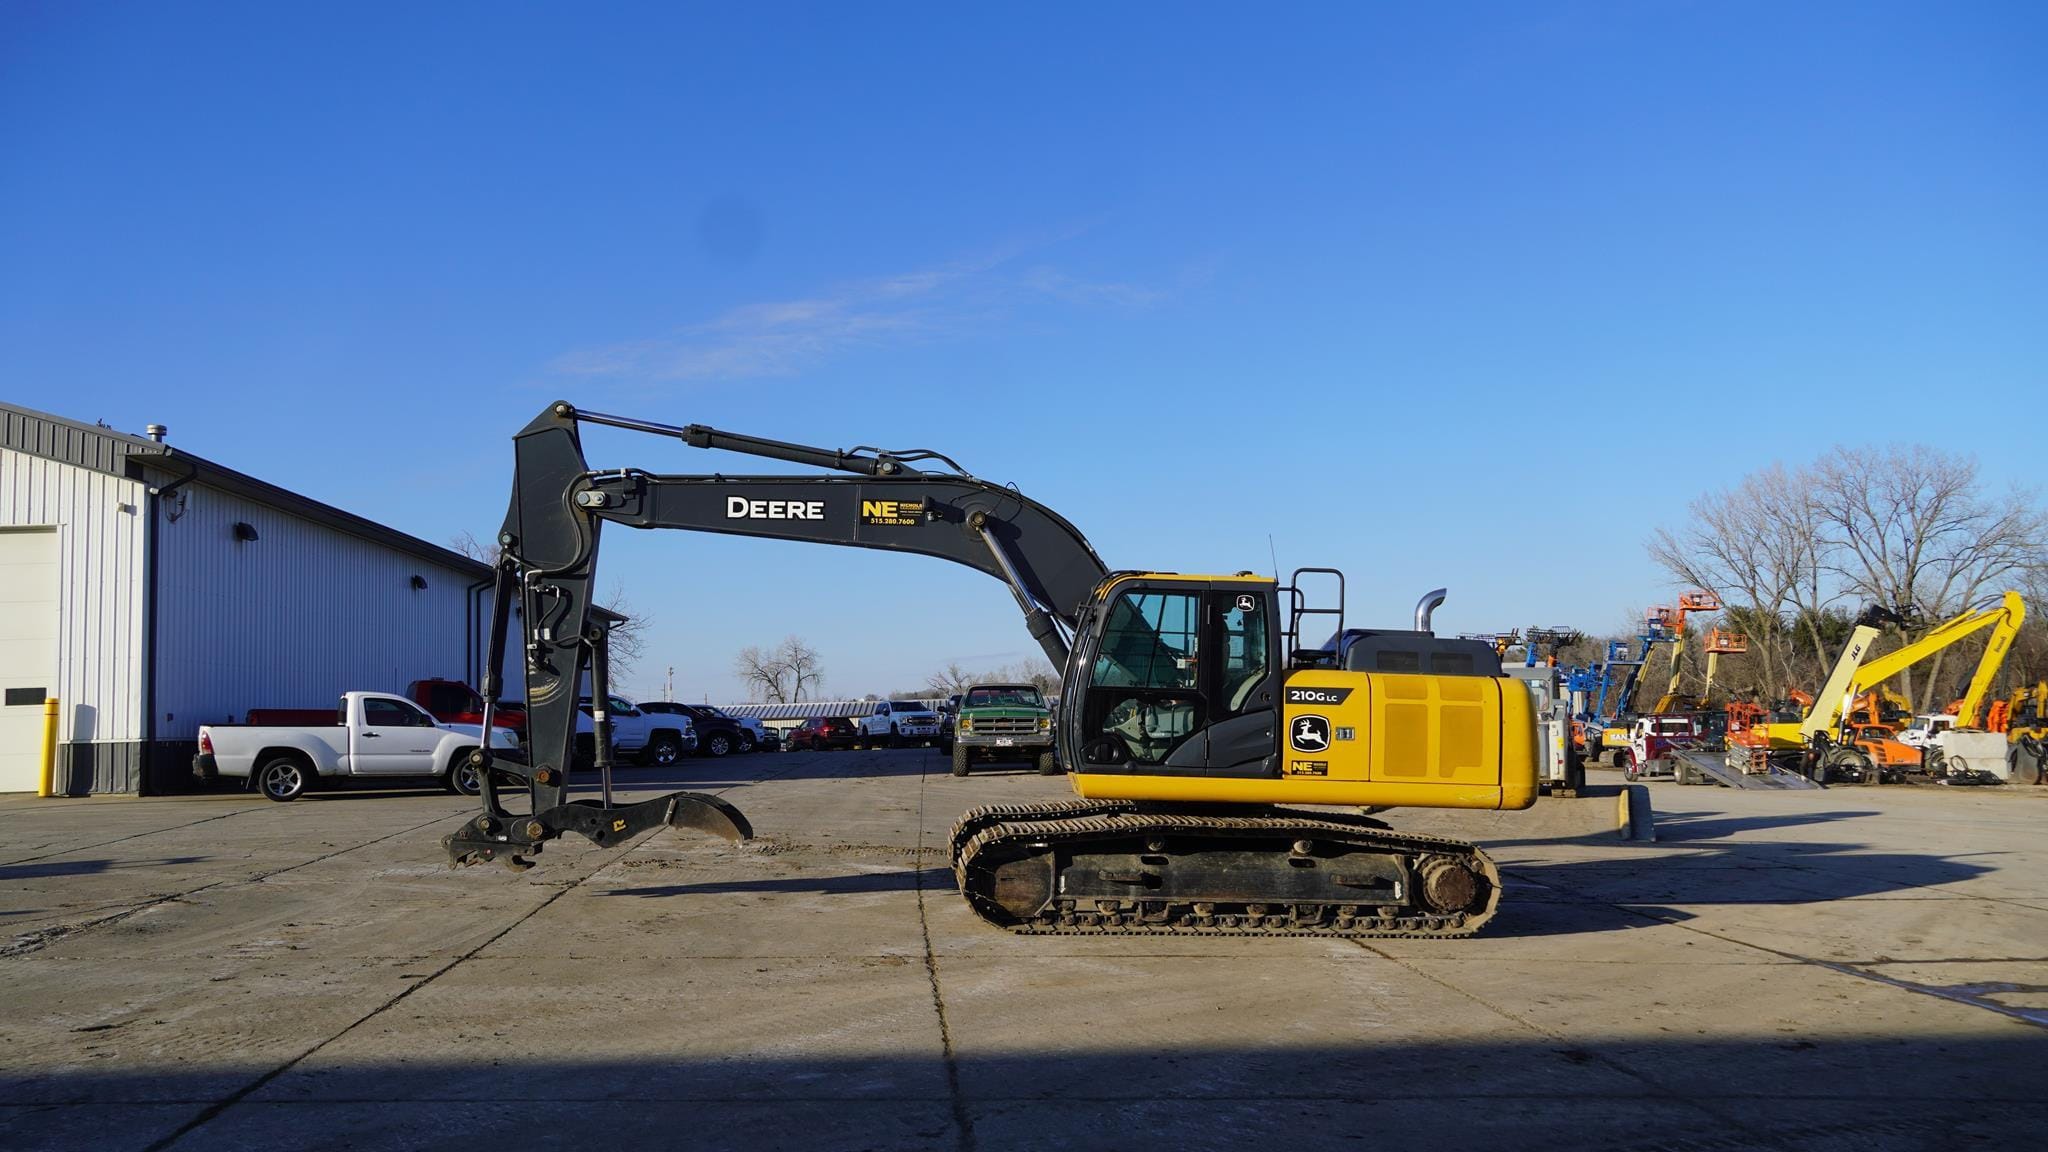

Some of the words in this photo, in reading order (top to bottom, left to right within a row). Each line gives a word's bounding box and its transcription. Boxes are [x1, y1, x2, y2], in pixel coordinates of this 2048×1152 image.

[727, 496, 824, 520] DEERE
[863, 501, 898, 518] NE
[1851, 644, 1861, 661] JLG
[1292, 761, 1313, 771] NE
